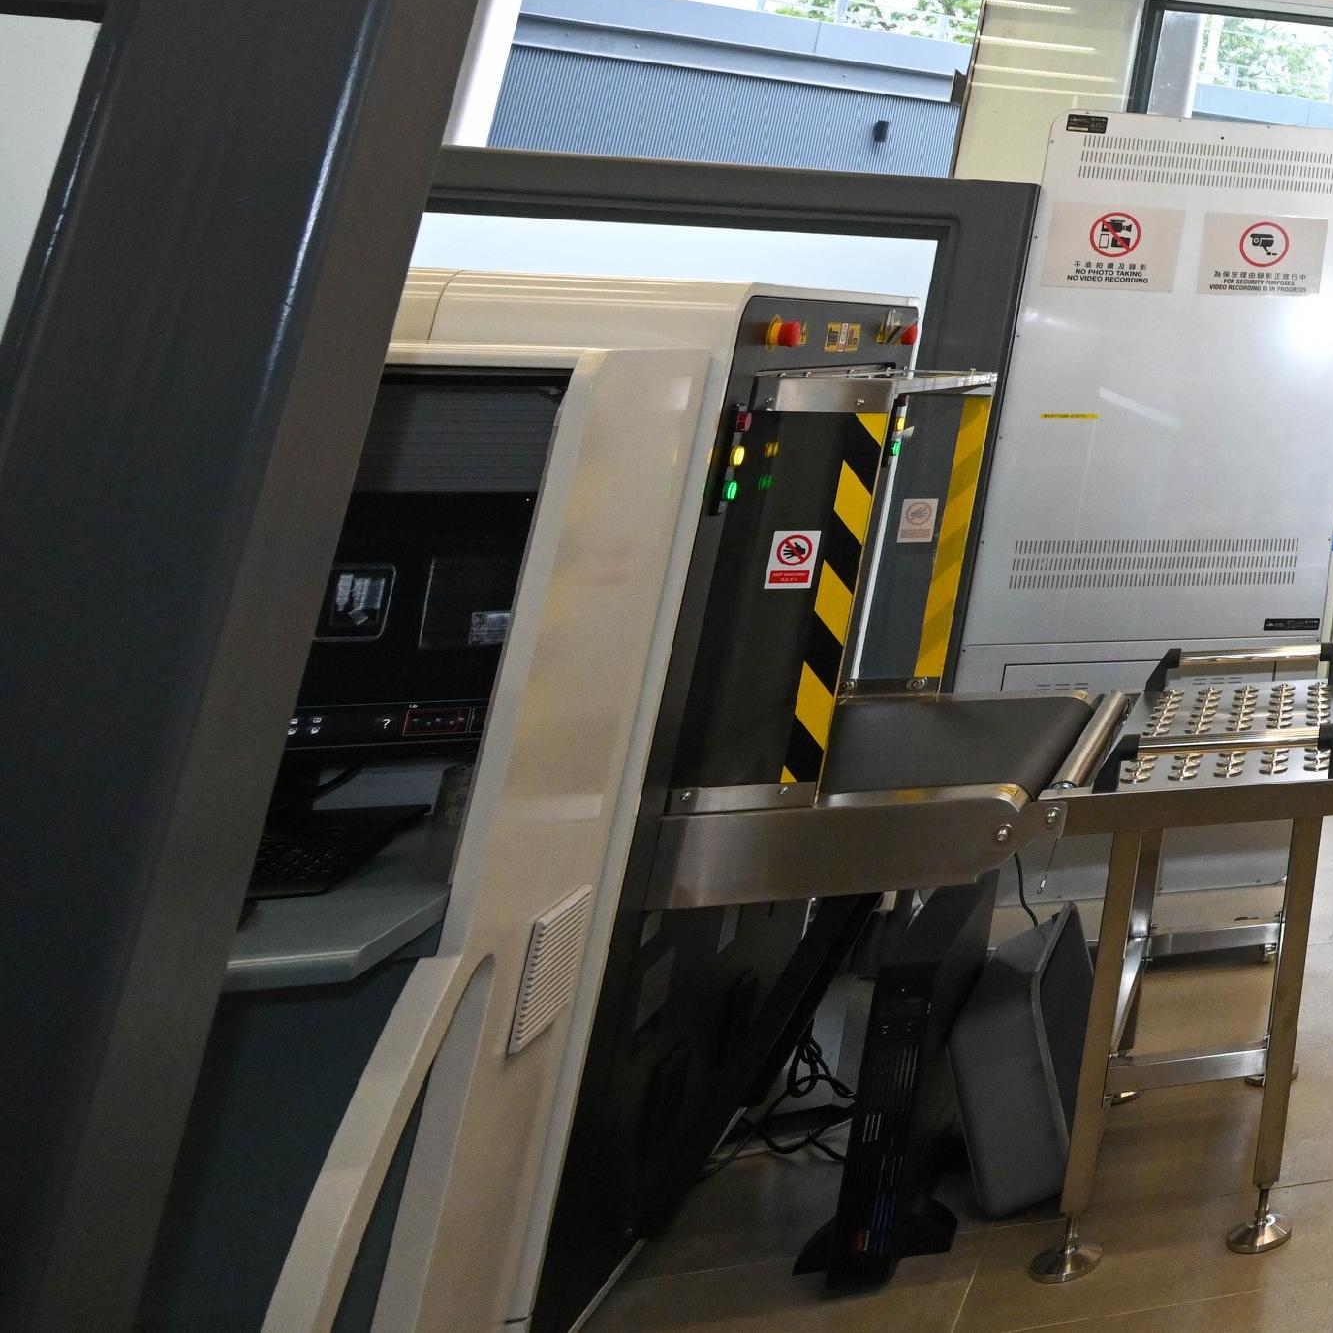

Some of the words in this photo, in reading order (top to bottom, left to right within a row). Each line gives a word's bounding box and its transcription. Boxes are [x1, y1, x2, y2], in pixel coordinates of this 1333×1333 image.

[1116, 270, 1143, 278] TAKING
[1105, 276, 1149, 284] RECORDING
[1228, 284, 1261, 292] RECORDING
